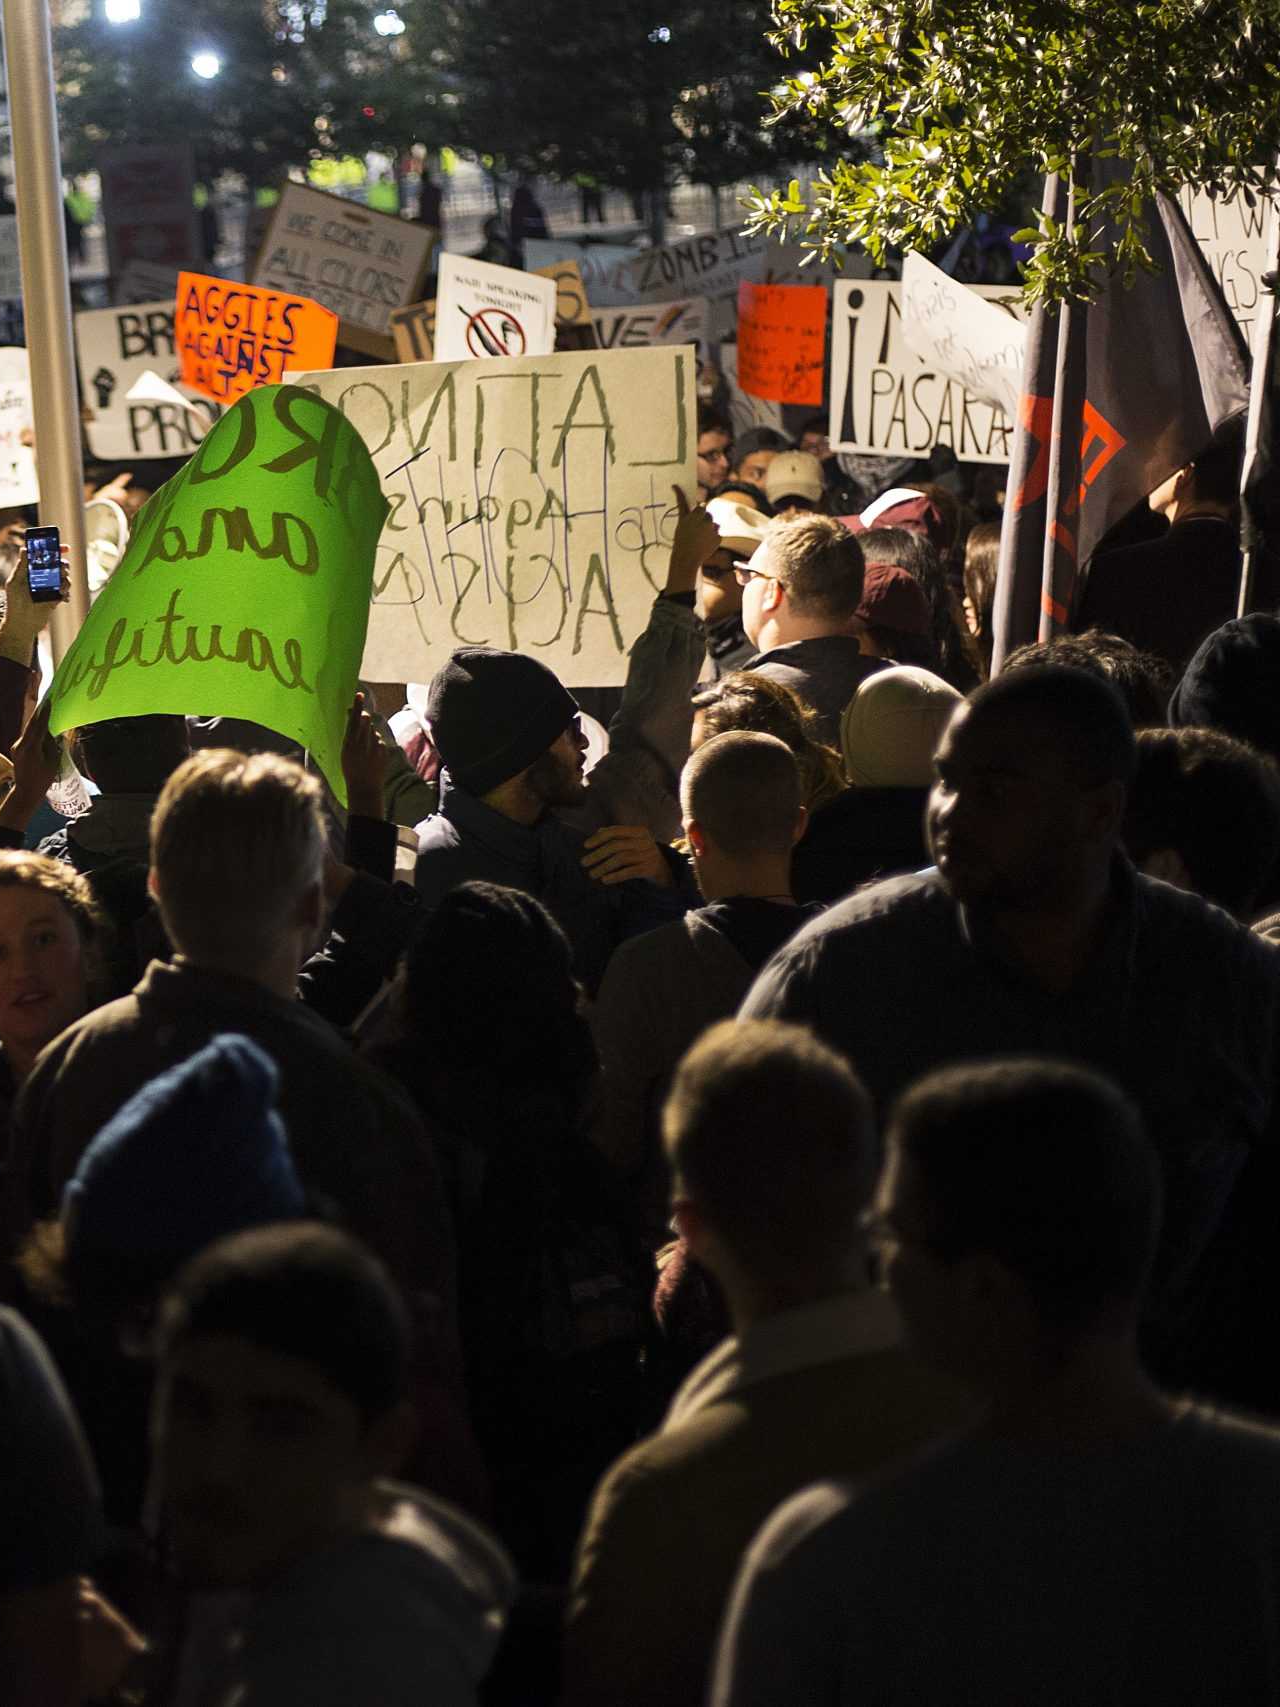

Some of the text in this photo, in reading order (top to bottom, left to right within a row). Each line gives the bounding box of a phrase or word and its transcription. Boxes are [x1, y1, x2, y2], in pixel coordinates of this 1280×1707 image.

[184, 286, 304, 345] AGGIES
[486, 280, 543, 305] SPEAKING
[185, 331, 296, 381] AGAINST
